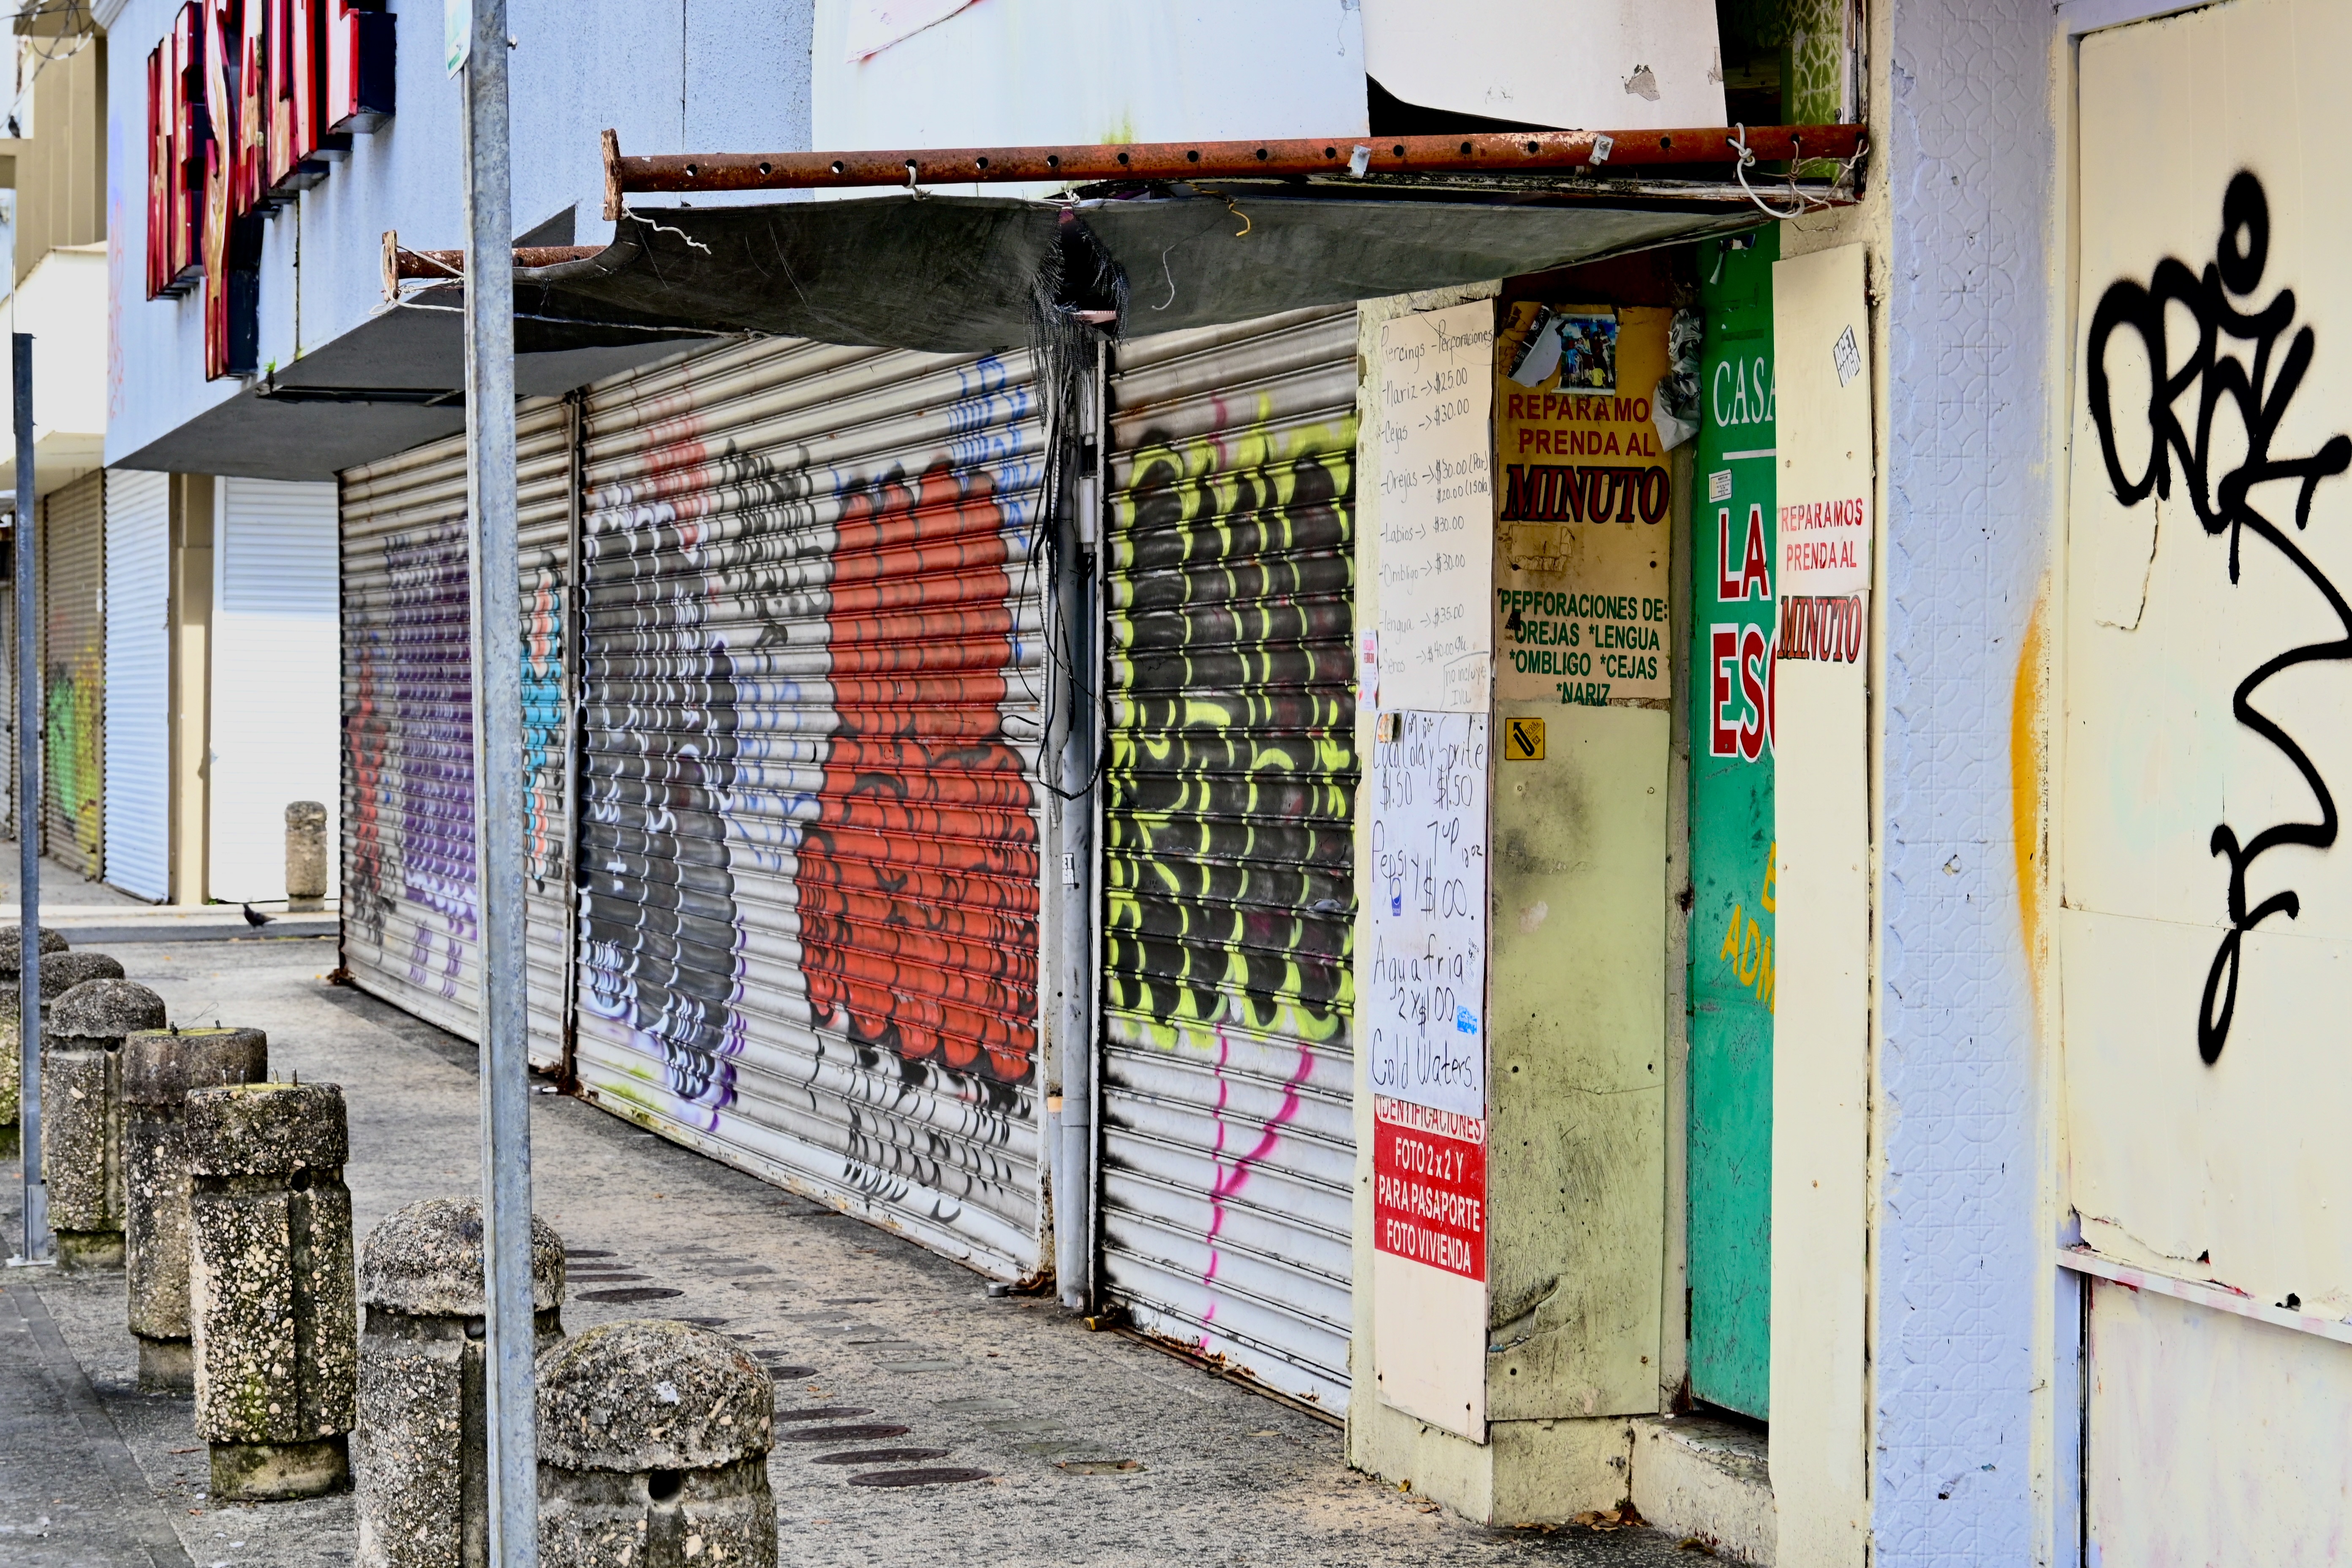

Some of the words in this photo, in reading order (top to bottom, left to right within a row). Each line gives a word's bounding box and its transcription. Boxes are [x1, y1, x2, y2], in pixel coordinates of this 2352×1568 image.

[1381, 325, 1425, 374] Piercings
[1434, 367, 1467, 394] $25.00
[1434, 398, 1469, 426] $30.00
[1508, 393, 1650, 423] REPARAMO
[1520, 428, 1620, 455] PRENDA
[1625, 432, 1656, 457] AL
[1434, 458, 1467, 485] $30.00
[1436, 485, 1463, 504] $20.00
[1500, 463, 1670, 525] MINUTO
[1433, 516, 1464, 534] $30.00
[1781, 498, 1863, 532] REPARAMOS
[1435, 553, 1465, 575] $30.00
[1717, 503, 1771, 603] LA
[1786, 542, 1837, 571] PRENDA
[1840, 541, 1857, 568] AL
[1432, 603, 1464, 629] $35.00
[1642, 598, 1668, 622] DE:
[1777, 594, 1862, 664] MINUTO
[1427, 640, 1454, 663] $40.00
[1445, 669, 1456, 687] no
[1458, 663, 1487, 686] incluye
[1710, 623, 1776, 764] ES
[1437, 714, 1484, 781] Sprite
[1433, 764, 1473, 811] $1.50
[1372, 820, 1407, 896] Pepsi
[1372, 1028, 1408, 1090] Cold
[1395, 1138, 1425, 1174] FOTO
[1456, 1152, 1463, 1183] Y
[1378, 1174, 1409, 1211] PARA
[1411, 1183, 1480, 1232] PASAPORTE
[1387, 1219, 1416, 1256] FOTO
[1418, 1227, 1471, 1274] VIVIENDA
